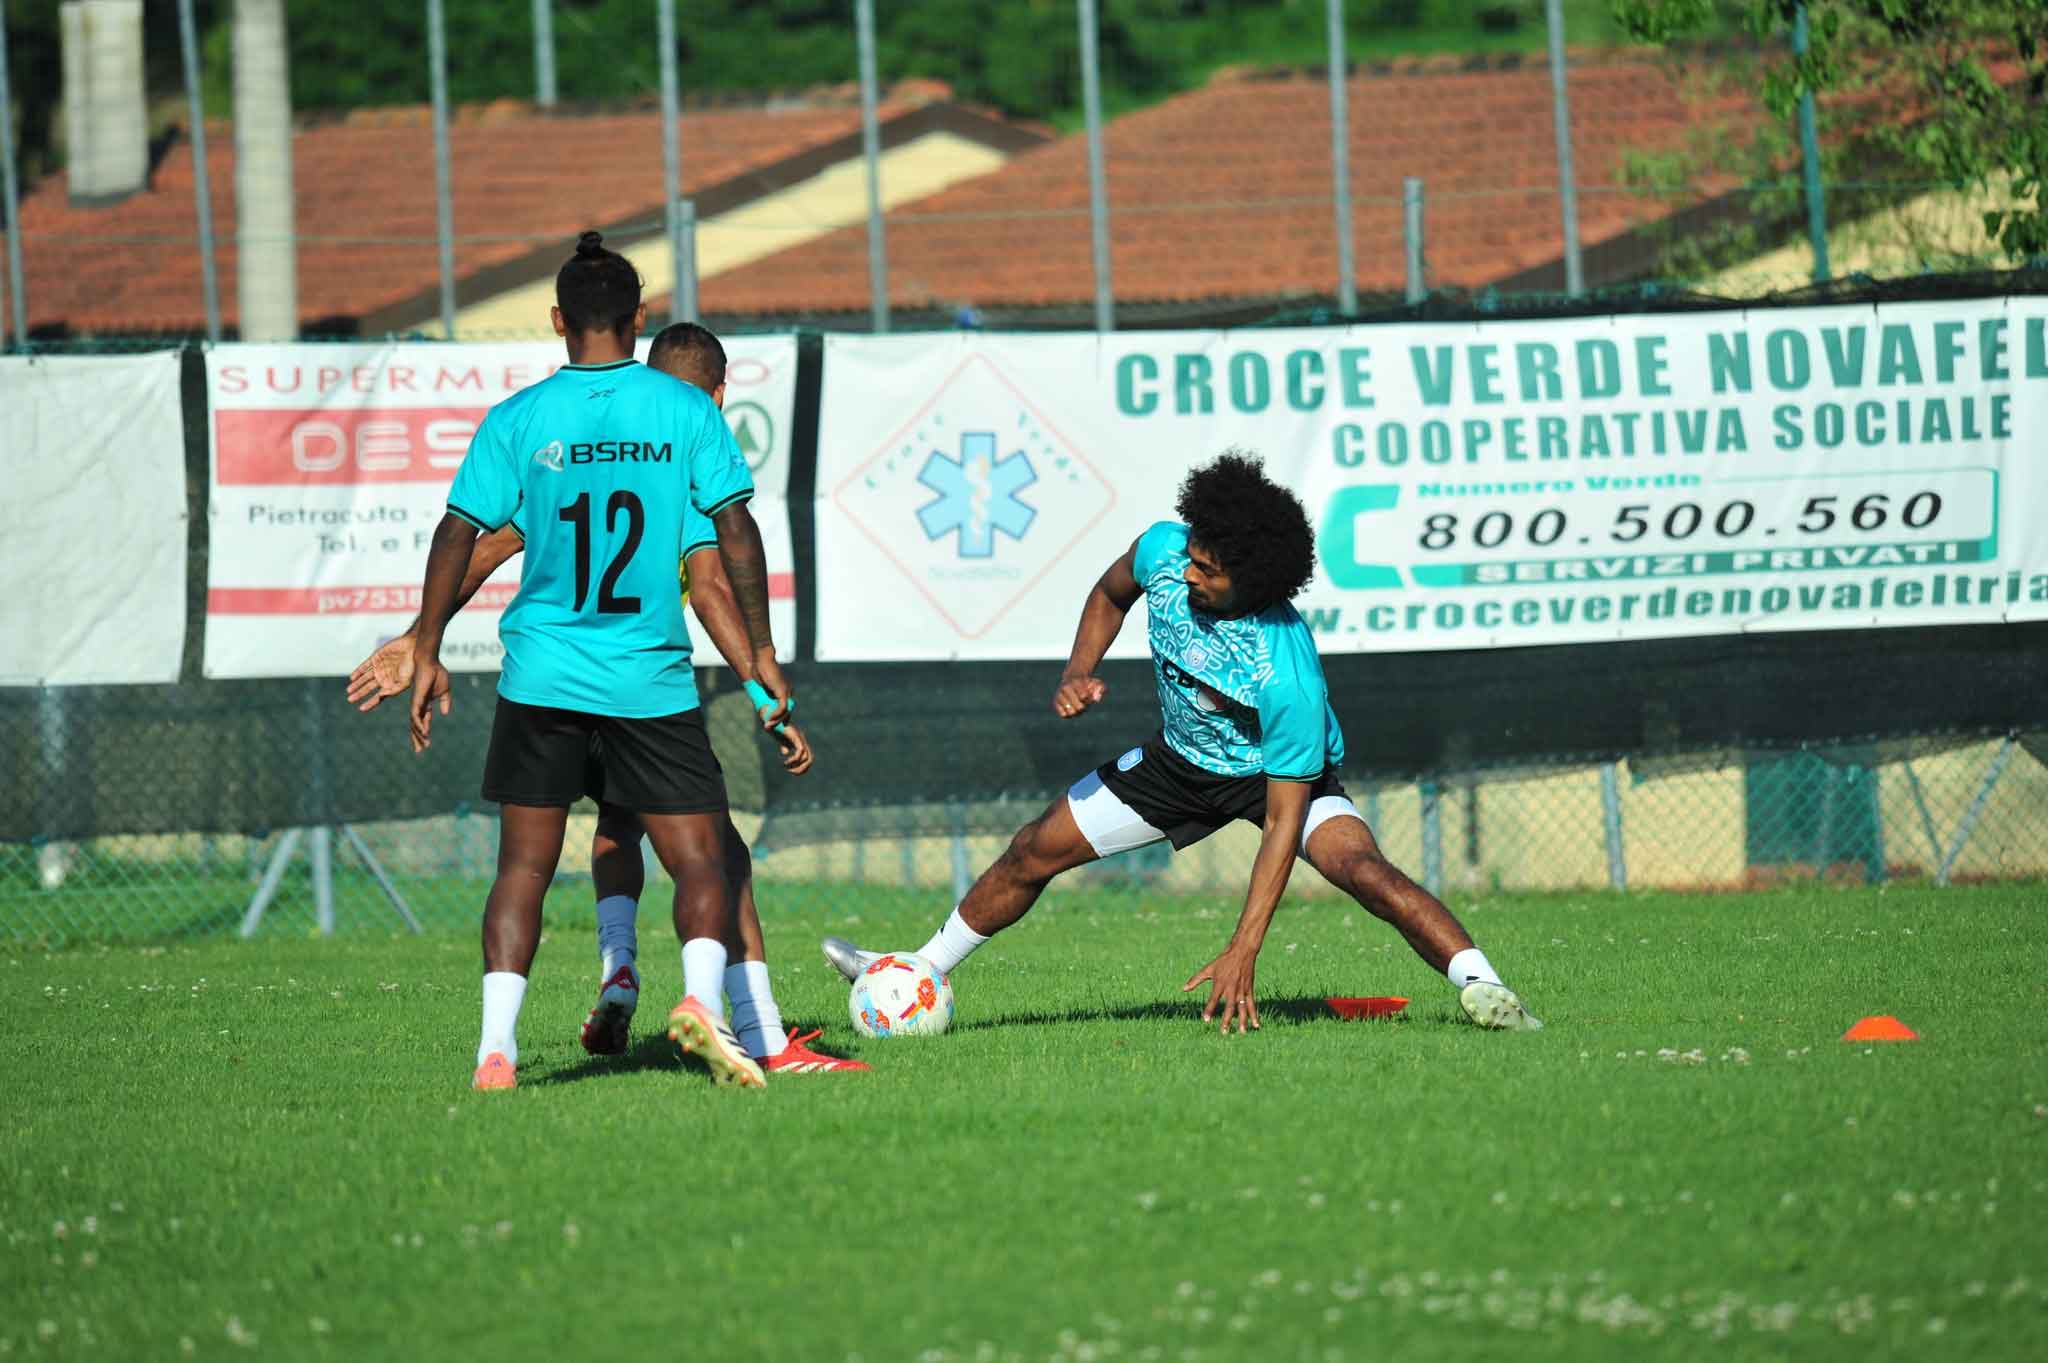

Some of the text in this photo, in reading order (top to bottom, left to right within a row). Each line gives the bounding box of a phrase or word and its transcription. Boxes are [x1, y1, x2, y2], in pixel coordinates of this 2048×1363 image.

[1114, 316, 2048, 418] CROCE VERDE NOVAFEL
[291, 419, 480, 472] DES
[570, 441, 673, 464] BSRM
[1332, 392, 2013, 468] COOPERATIVA SOCIALE
[1583, 471, 1704, 491] Verde
[1418, 491, 1942, 551] 800.500.560
[558, 489, 645, 615] 12
[1474, 542, 1959, 584] SERVIZI PRIVATI
[1300, 570, 2048, 634] w.croceverdenovafeltria
